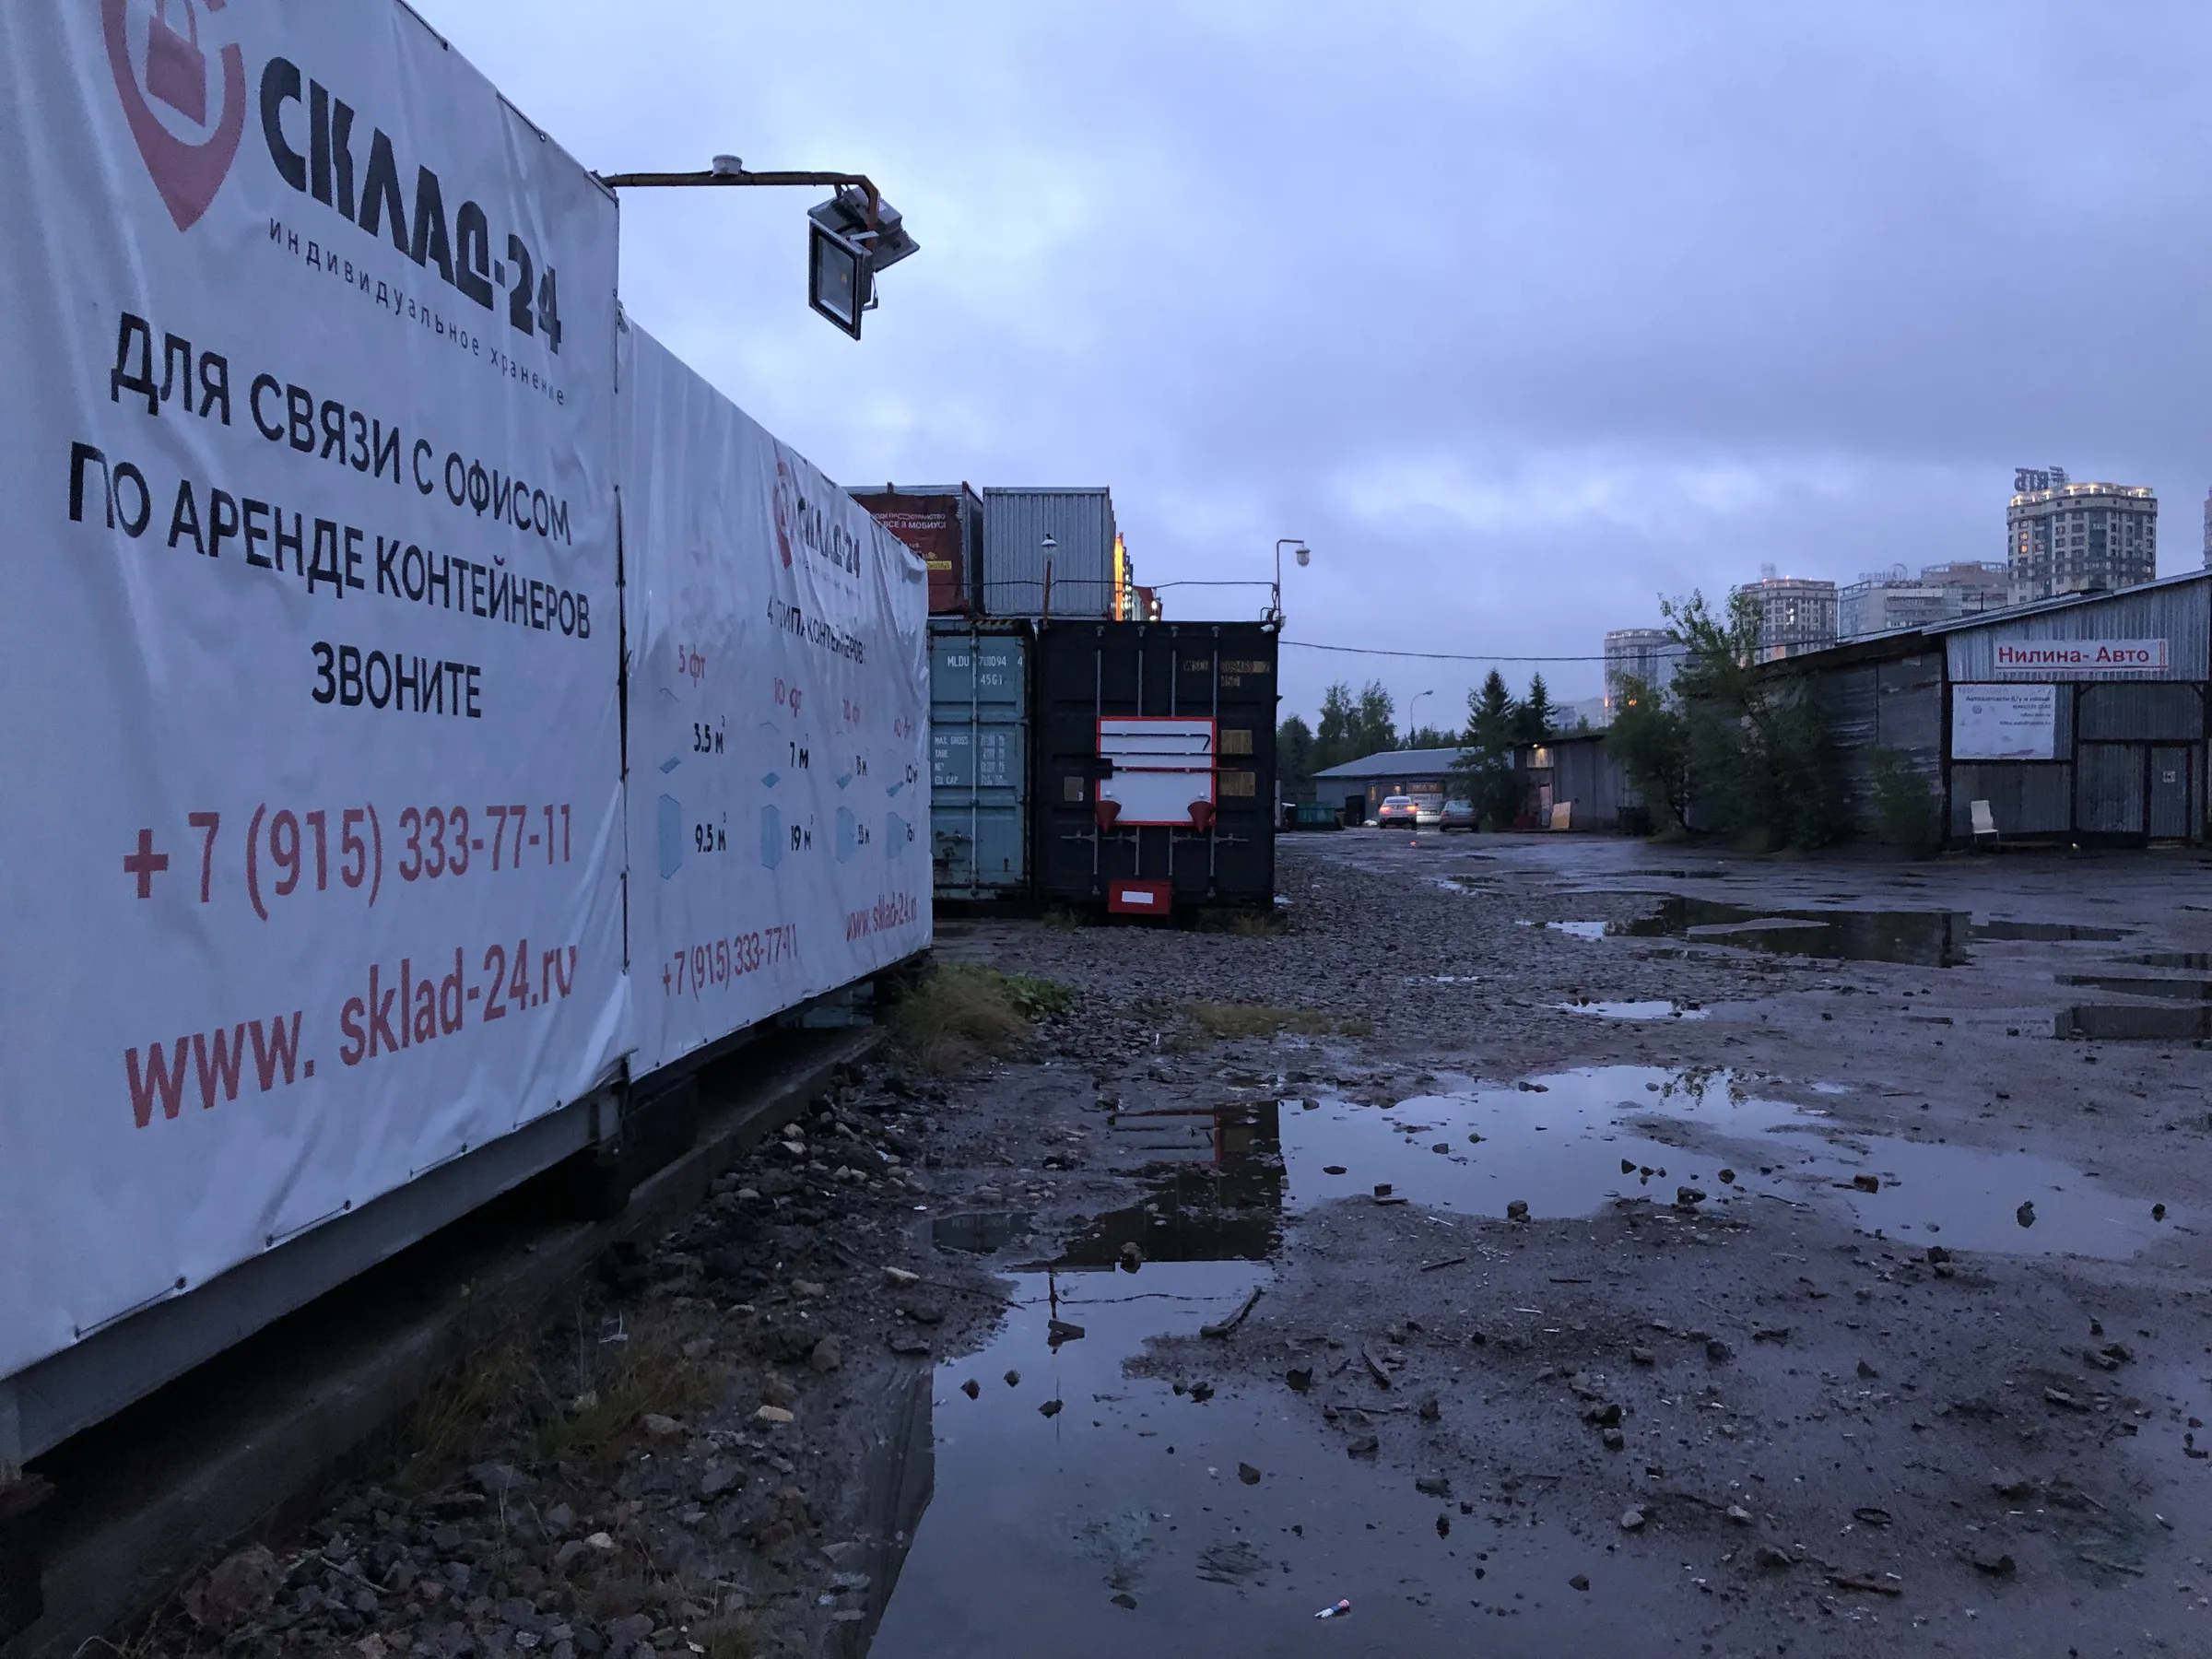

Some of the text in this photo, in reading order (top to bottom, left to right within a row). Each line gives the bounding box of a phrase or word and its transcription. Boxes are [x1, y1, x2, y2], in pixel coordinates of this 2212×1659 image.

[260, 56, 563, 355] СКЛАД-24
[269, 218, 566, 406] индивидуальное хранение
[111, 312, 572, 547] ДЛЯ СВЯЗИ С ОФИСОМ
[69, 441, 591, 640] ПО АРЕНДЕ КОНТЕЙНЕРОВ
[767, 594, 775, 625] 4
[678, 642, 706, 688] 5 фт
[947, 655, 970, 667] MLDU
[1017, 655, 1023, 666] 4
[2096, 646, 2149, 663] Авто
[311, 641, 482, 718] ЗВОНИТЕ
[774, 677, 786, 706] 10
[693, 723, 712, 753] 3.5
[790, 741, 795, 768] 7
[695, 824, 713, 853] 9.5
[791, 825, 801, 851] 19
[247, 803, 382, 921] (915)
[398, 803, 571, 882] 333-77-11
[690, 937, 731, 1002] (915)
[735, 924, 798, 975] 333-77-11
[124, 939, 577, 1128] www. sklad-24.ru
